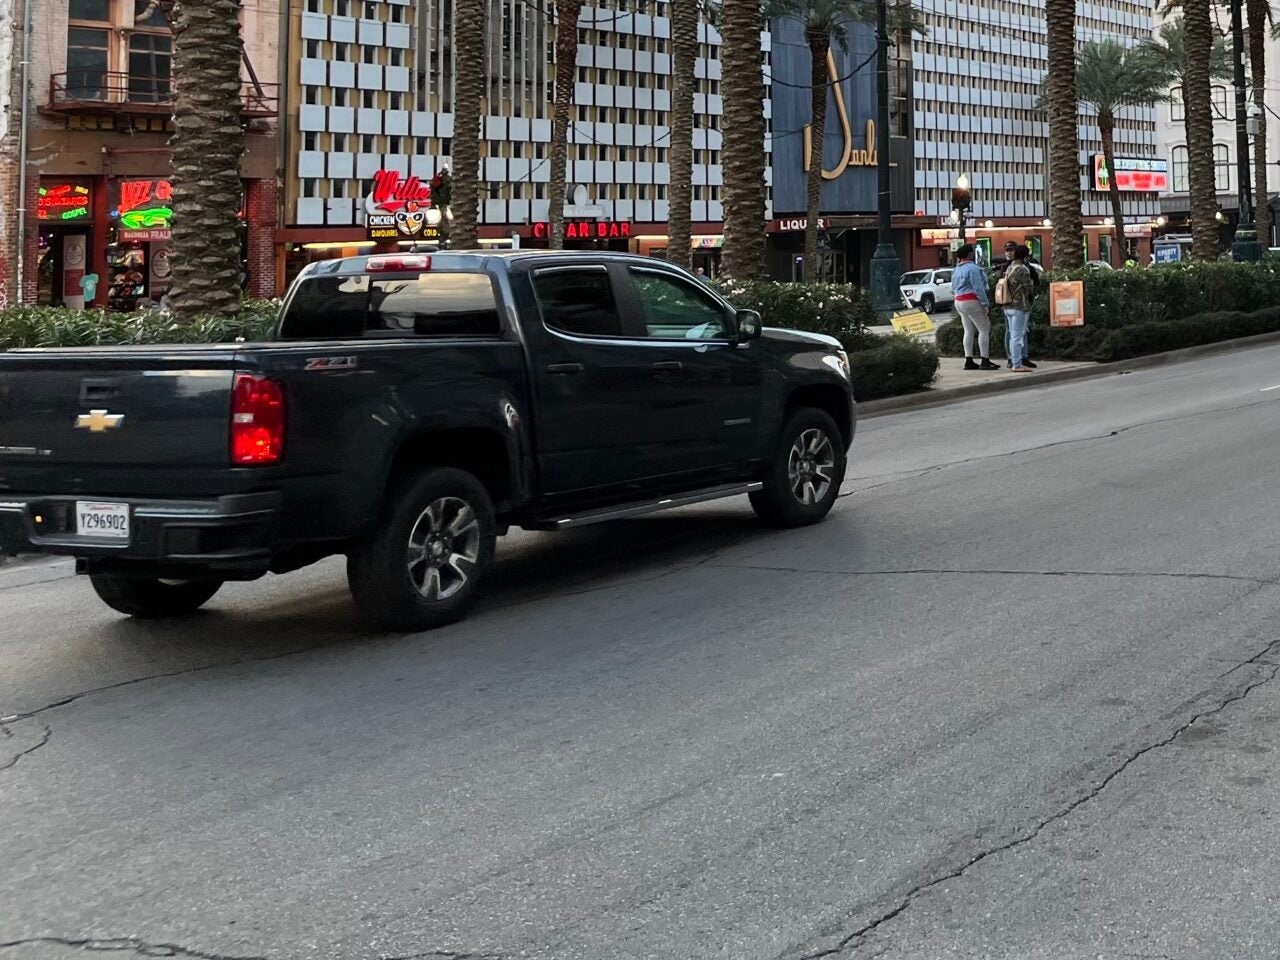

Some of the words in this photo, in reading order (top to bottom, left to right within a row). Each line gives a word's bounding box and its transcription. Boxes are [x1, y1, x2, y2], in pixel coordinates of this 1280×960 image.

[370, 215, 395, 225] CHICKEN
[780, 219, 824, 231] LIQUR
[423, 228, 437, 237] COLD
[534, 222, 589, 238] CIAR
[598, 222, 630, 238] BAR
